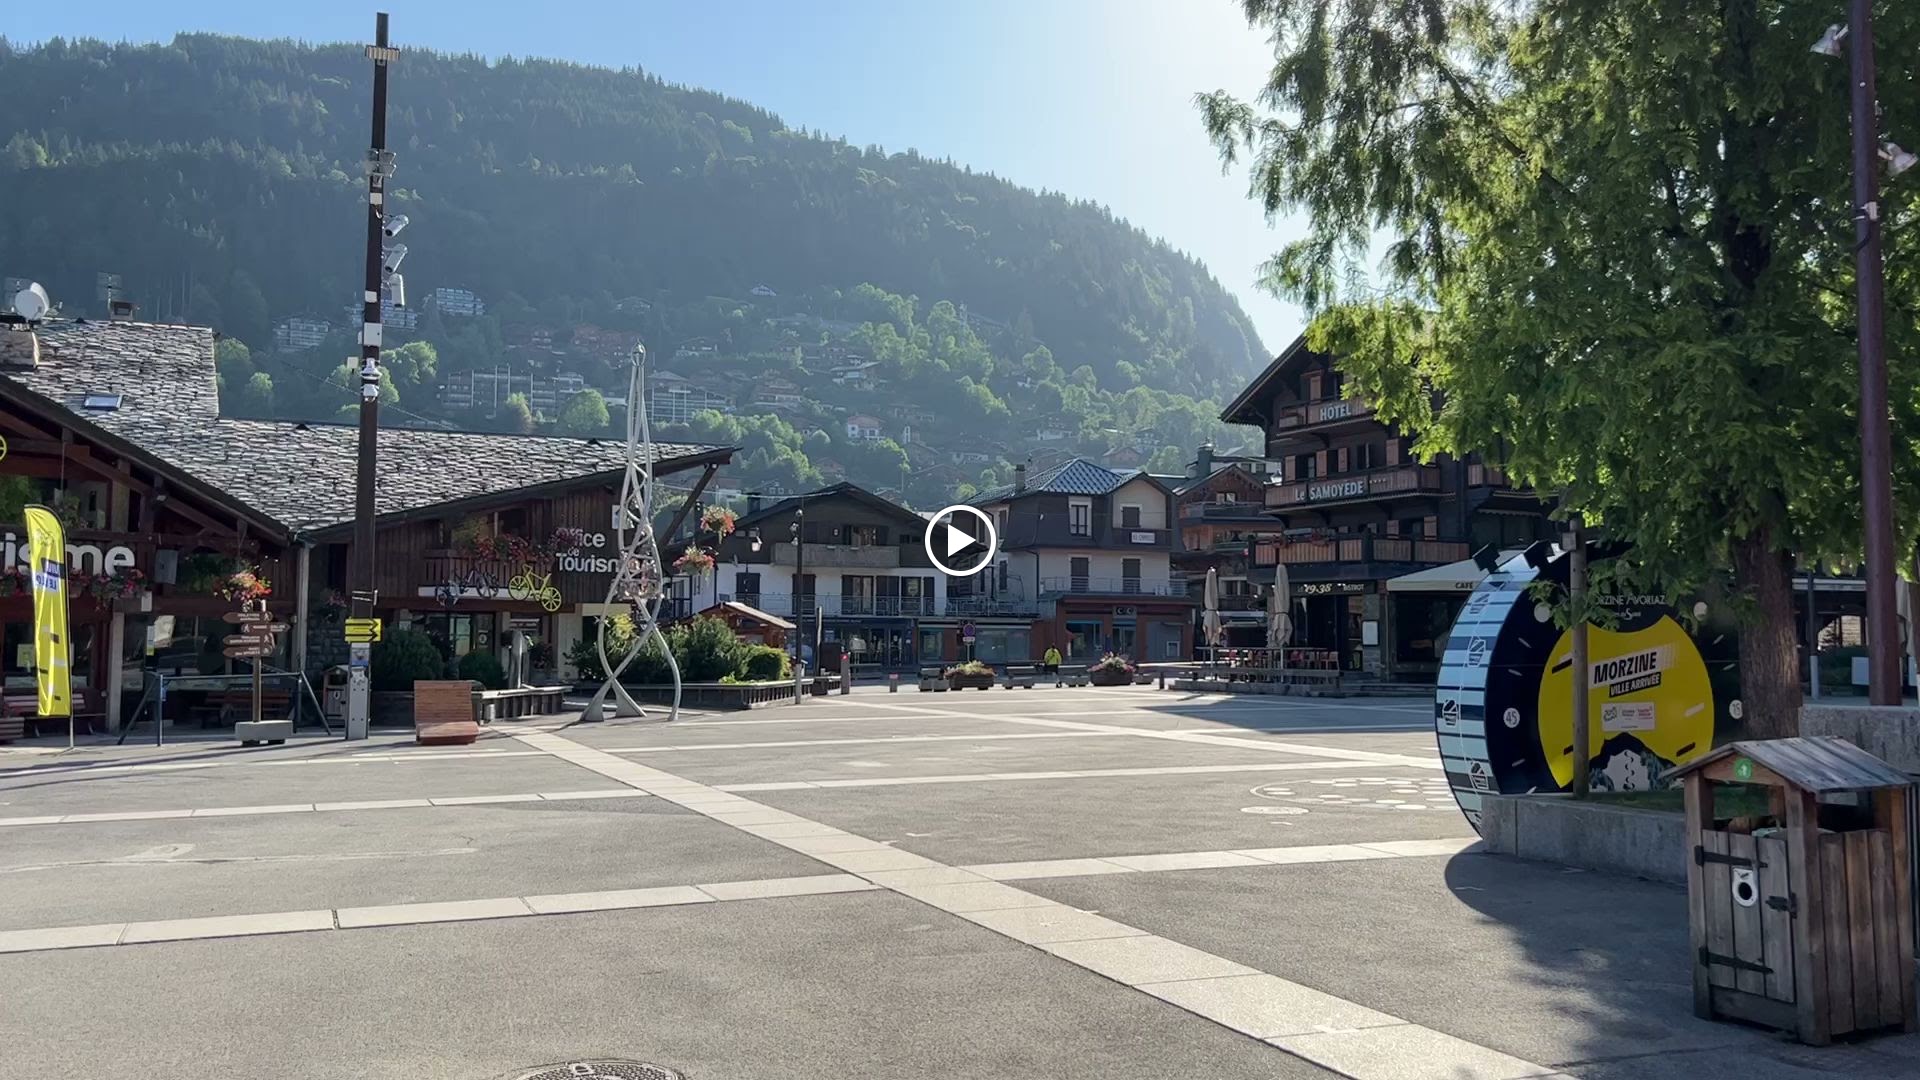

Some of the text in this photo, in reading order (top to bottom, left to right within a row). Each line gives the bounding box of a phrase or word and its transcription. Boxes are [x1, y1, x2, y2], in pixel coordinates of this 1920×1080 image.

[1295, 487, 1305, 501] Le
[555, 552, 632, 573] Tourism
[1593, 651, 1658, 685] MORZINE
[1610, 682, 1630, 696] VILLE
[1732, 702, 1740, 716] 15
[1506, 711, 1518, 725] 45
